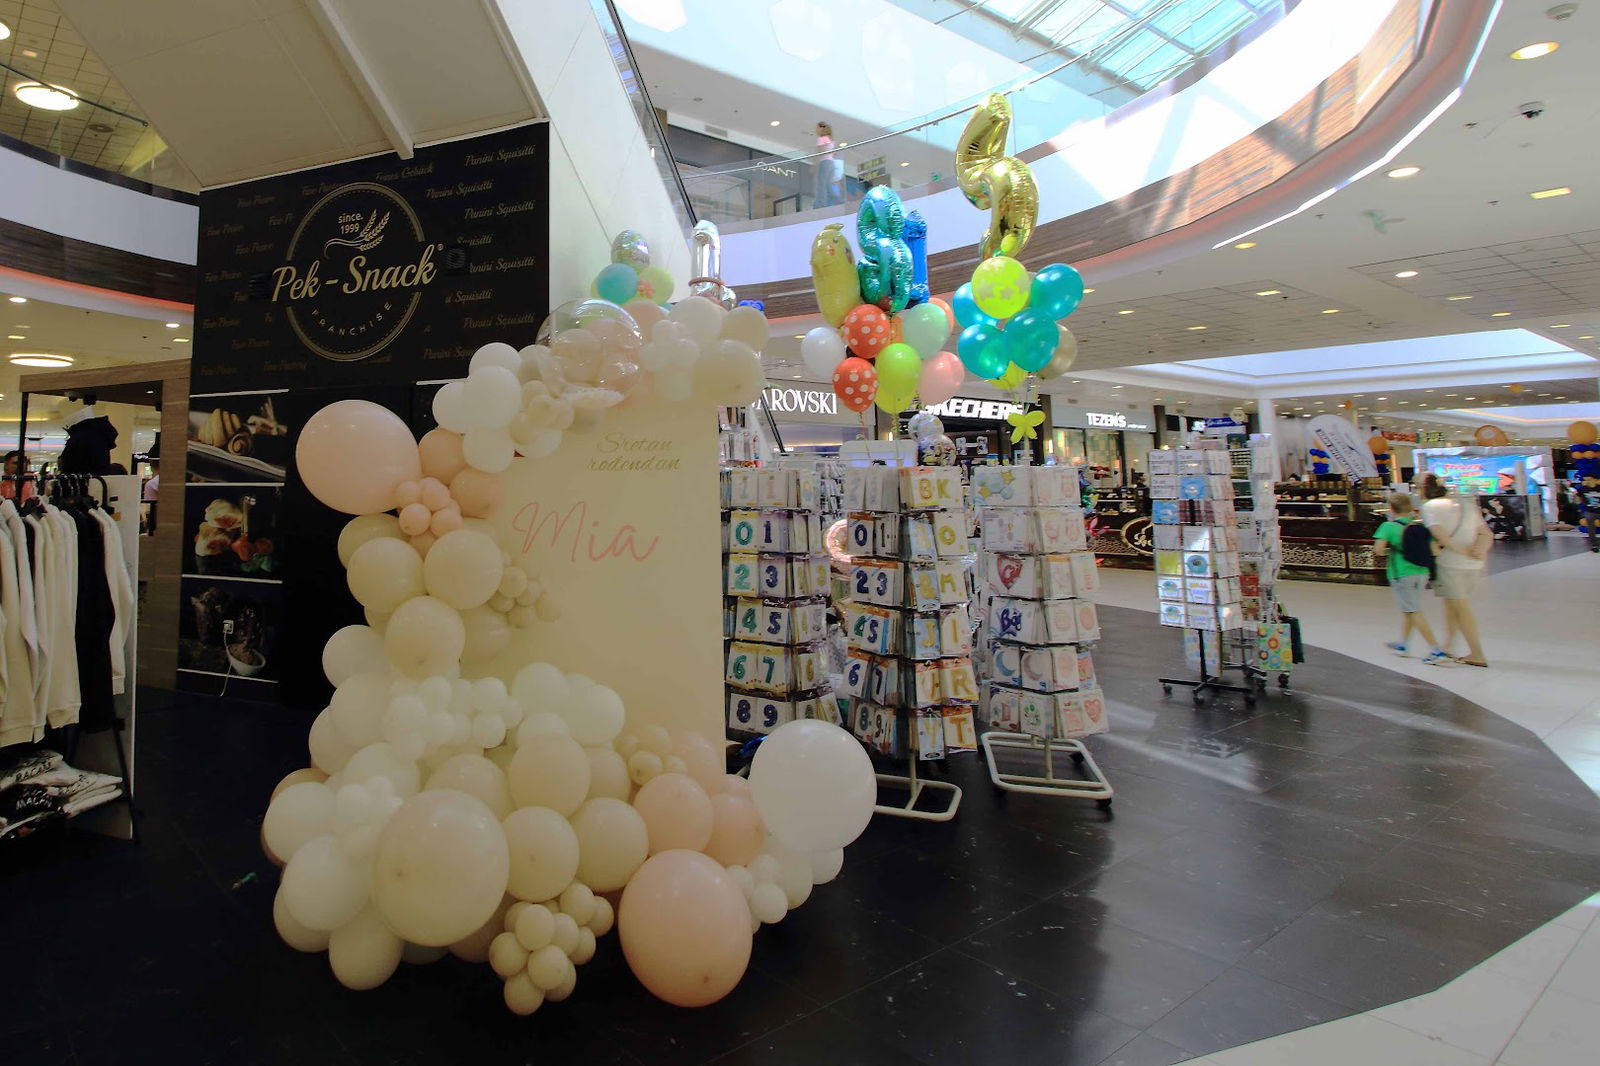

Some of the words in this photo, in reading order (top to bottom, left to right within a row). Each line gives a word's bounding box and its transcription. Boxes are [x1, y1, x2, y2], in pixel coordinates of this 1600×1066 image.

[340, 223, 360, 235] 1999
[271, 259, 322, 302] Pek
[342, 243, 438, 294] Snack
[311, 301, 393, 336] FRANCHISE
[512, 500, 660, 563] Mia
[735, 521, 752, 546] 0
[763, 520, 772, 544] 1
[854, 524, 867, 547] 0
[735, 563, 751, 590] 2
[766, 564, 778, 589] 3
[856, 570, 869, 594] 2
[876, 571, 888, 597] 3
[742, 607, 757, 633] 4
[767, 611, 782, 635] 5
[867, 619, 879, 644] 5
[921, 620, 935, 648] J
[733, 655, 747, 680] 6
[763, 656, 775, 684] 7
[848, 663, 861, 687] 6
[950, 669, 974, 695] R
[737, 699, 751, 723] 8
[763, 704, 778, 727] 9
[860, 706, 869, 731] 8
[875, 714, 882, 738] 9
[949, 716, 968, 743] T
